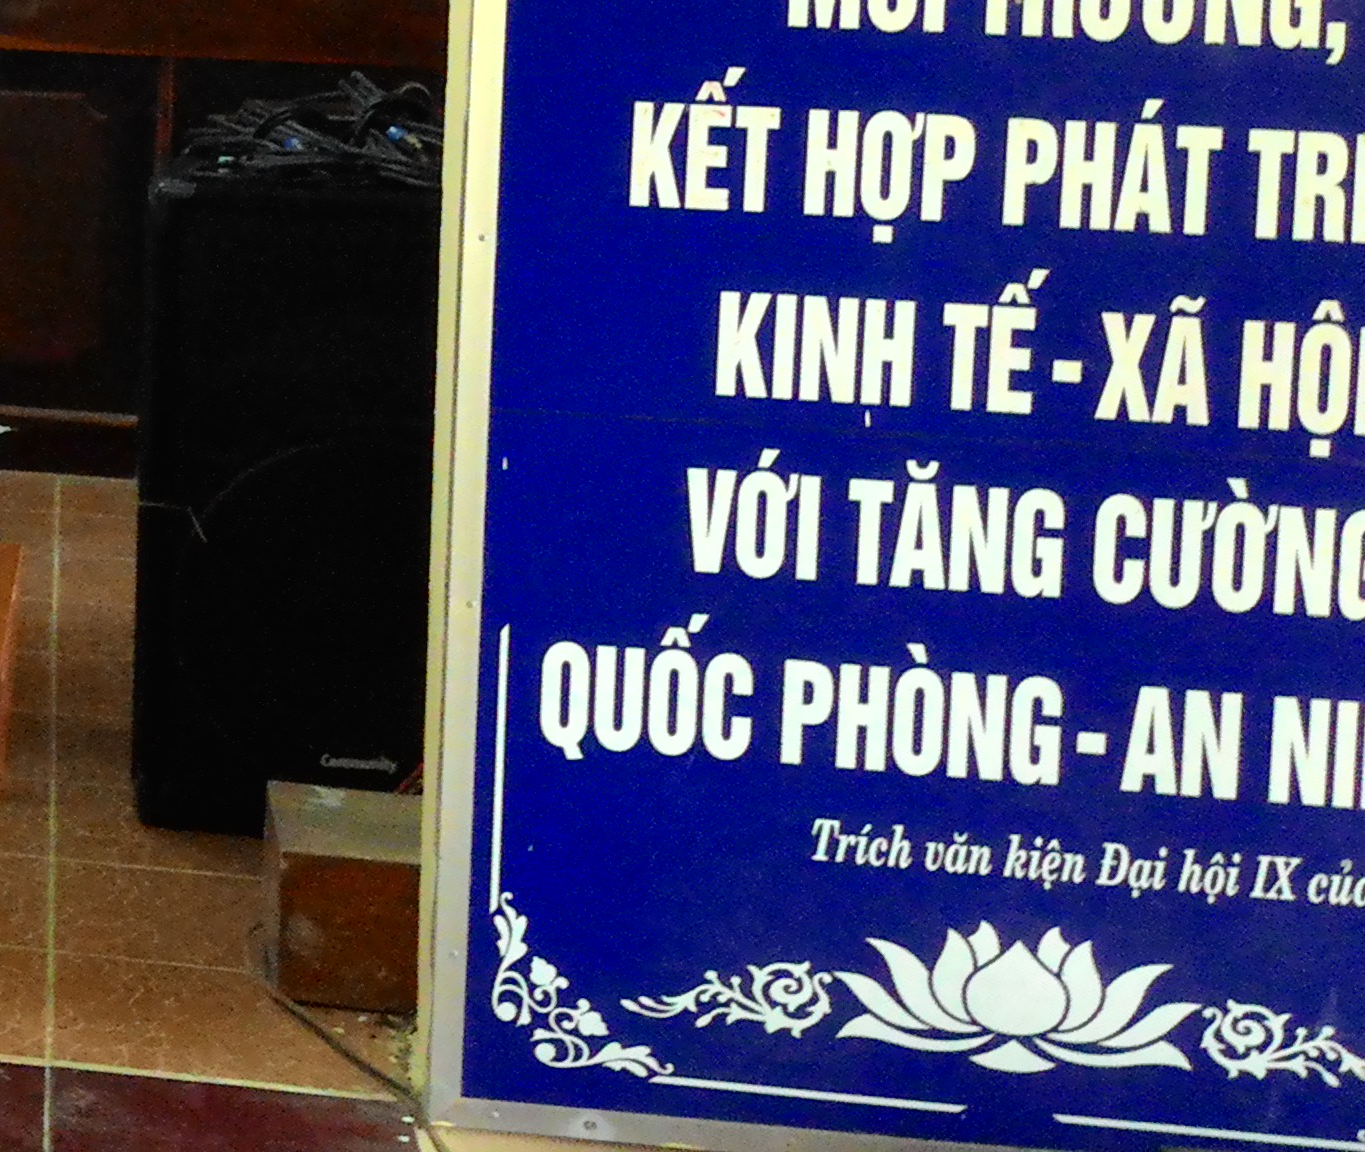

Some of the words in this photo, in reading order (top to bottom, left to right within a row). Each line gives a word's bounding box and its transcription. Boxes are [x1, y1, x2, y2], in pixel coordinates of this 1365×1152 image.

[629, 67, 781, 212] KẾT
[804, 109, 976, 243] HỢP
[1002, 99, 1224, 235] PHÁT
[715, 291, 916, 407] KINH
[687, 448, 821, 580] VỚI
[848, 460, 1065, 598] TĂNG
[540, 614, 753, 760] QUỐC
[1268, 696, 1365, 810] NI
[812, 818, 912, 869] Trích
[925, 832, 992, 875] văn
[1003, 834, 1085, 890] kiện
[1096, 842, 1168, 898] Đại
[1178, 849, 1241, 904] hội
[1250, 855, 1302, 900] IX
